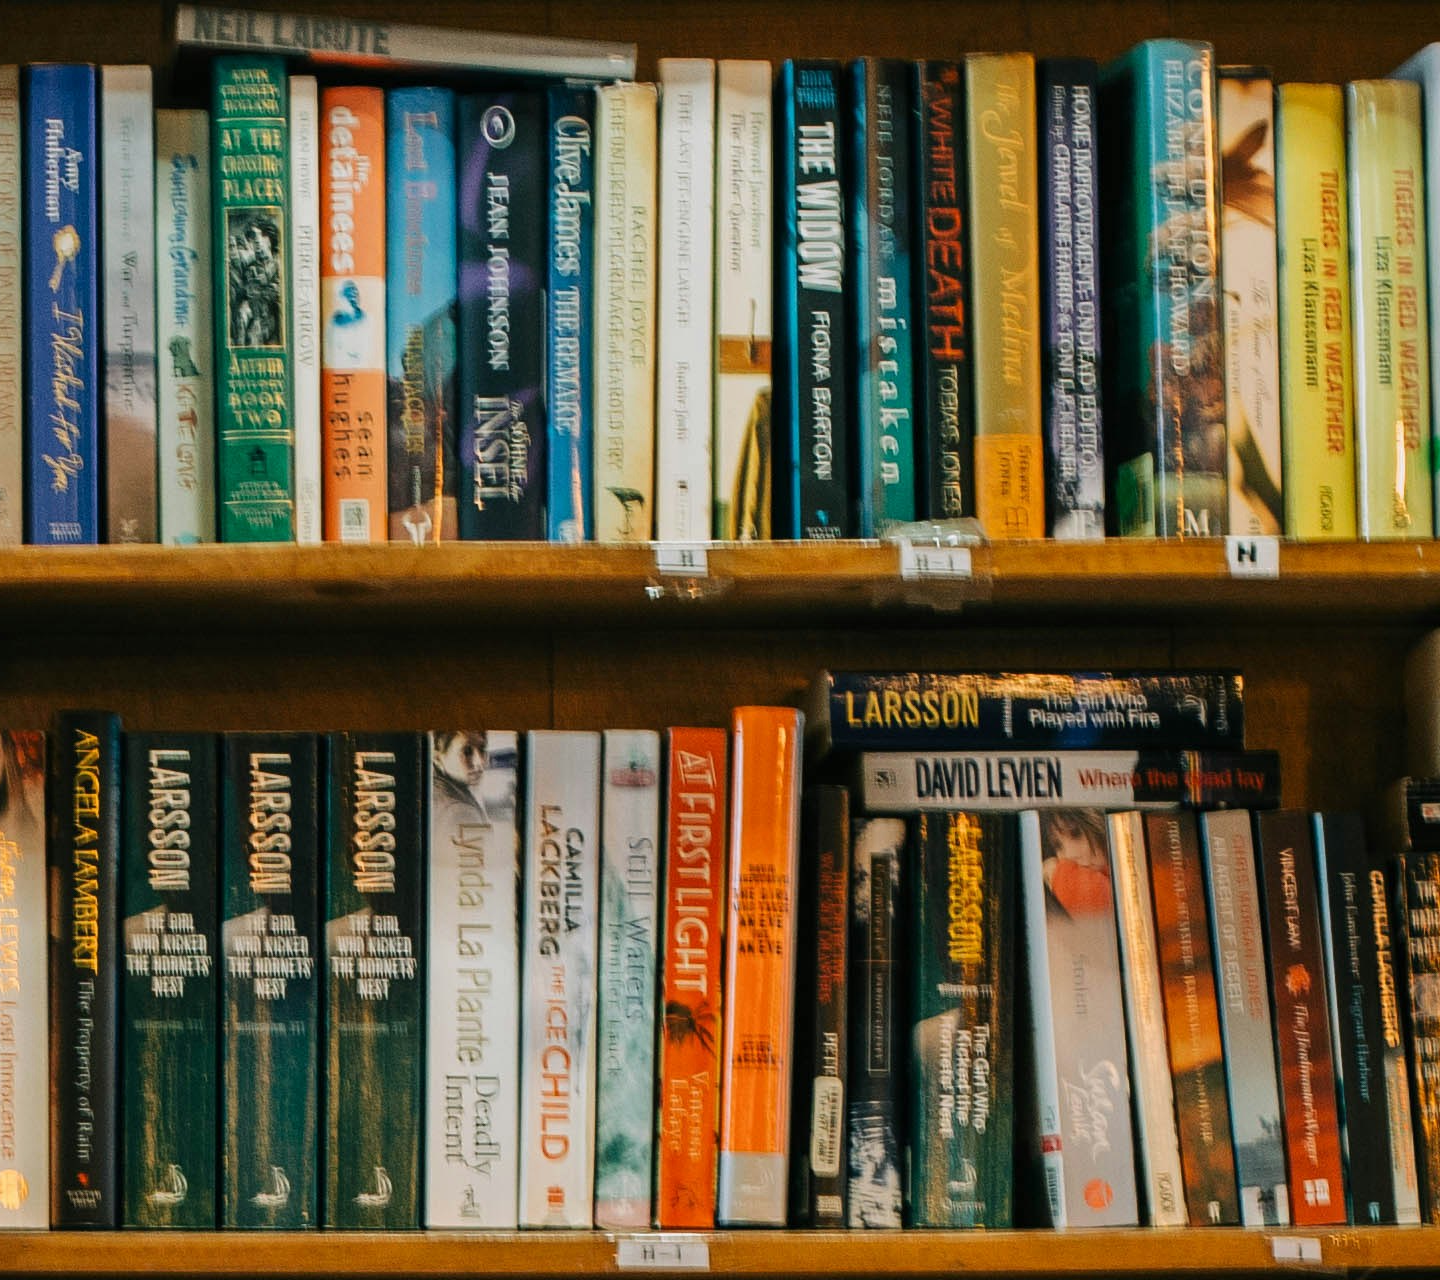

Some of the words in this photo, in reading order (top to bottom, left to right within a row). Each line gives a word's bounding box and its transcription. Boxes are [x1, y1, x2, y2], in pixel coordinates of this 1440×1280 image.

[798, 123, 838, 172] THE
[797, 181, 843, 292] WIDOW
[811, 310, 832, 376] FIONA
[811, 386, 832, 478] BARTON
[845, 690, 979, 728] LARSSON
[677, 750, 711, 787] AT
[915, 757, 979, 799] DAVID
[986, 757, 1063, 798] LEVIEN
[146, 749, 189, 888] LARSSON
[246, 750, 294, 893] LARSSON
[351, 750, 397, 891] LARSSON
[675, 792, 714, 880] FIRST
[672, 889, 712, 994] LIGHT
